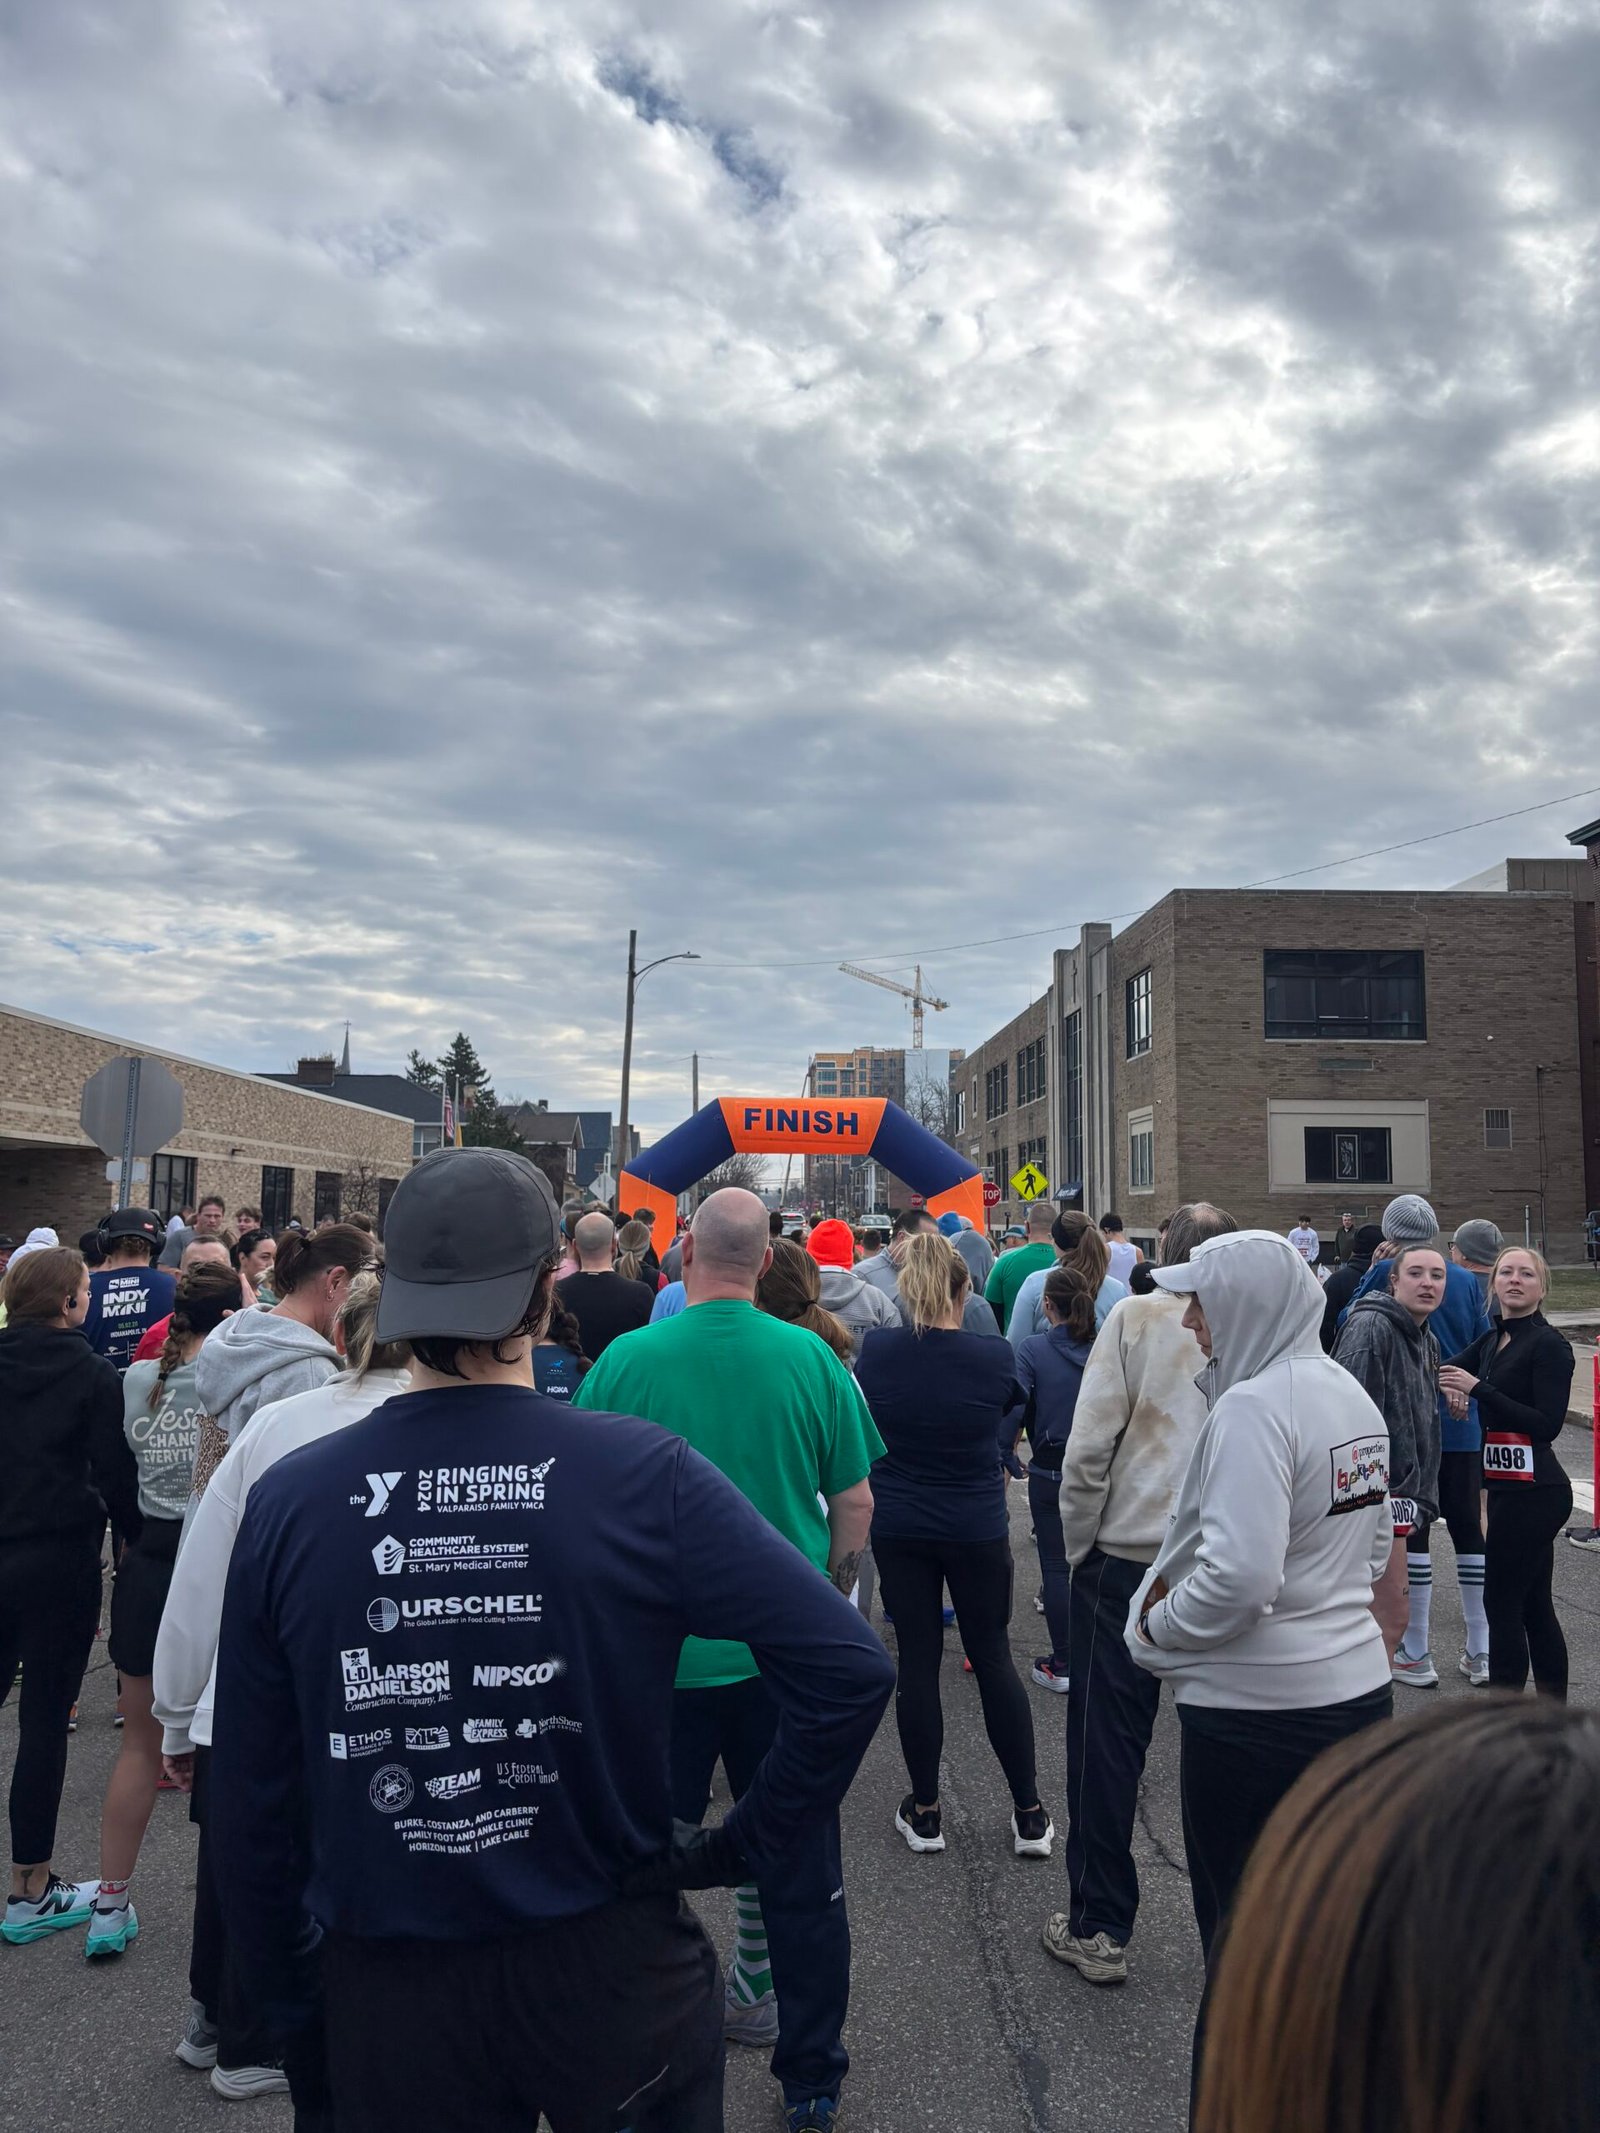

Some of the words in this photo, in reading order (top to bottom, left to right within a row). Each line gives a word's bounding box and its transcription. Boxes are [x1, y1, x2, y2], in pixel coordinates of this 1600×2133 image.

[744, 1108, 858, 1135] FINISH
[983, 1190, 999, 1200] TOP
[102, 1288, 150, 1305] INDY
[102, 1302, 147, 1318] MINI
[148, 1431, 197, 1448] CHANG
[1486, 1446, 1526, 1470] 4498
[436, 1465, 528, 1485] RINGING
[350, 1494, 367, 1505] the
[417, 1470, 433, 1512] 2024
[436, 1485, 459, 1504] IN
[466, 1483, 545, 1502] SPRING
[437, 1503, 488, 1513] VALPARAISO
[490, 1502, 519, 1511] FAMILY
[521, 1502, 544, 1510] YMCA
[409, 1536, 476, 1547] COMMUNITY
[409, 1545, 481, 1557] HEALTHCARE
[409, 1564, 422, 1573] St.
[425, 1562, 451, 1573] Mary
[454, 1560, 491, 1570] Medical
[495, 1560, 528, 1569] Center
[416, 1619, 437, 1627] Global
[438, 1617, 459, 1625] Leader
[483, 1616, 506, 1624] Cutting
[507, 1615, 542, 1623] Technology
[372, 1660, 450, 1681] LARSON
[472, 1662, 554, 1687] NIPSCO
[345, 1675, 451, 1702] DANIELSON
[345, 1695, 396, 1712] Construction
[397, 1695, 436, 1708] Company,
[438, 1691, 453, 1702] Inc.
[474, 1719, 504, 1728] FAMILY
[539, 1715, 583, 1730] NorthShore
[348, 1728, 392, 1747] ETHOS
[471, 1728, 508, 1738] EXPRESS
[438, 1767, 481, 1792] TEAM
[394, 1818, 426, 1830] BURKE,
[427, 1819, 474, 1830] COSTANZA,
[475, 1811, 493, 1824] AND
[494, 1806, 540, 1818] CARBERRY
[402, 1830, 432, 1840] FAMILY
[433, 1832, 454, 1842] FOOT
[456, 1830, 476, 1841] AND
[477, 1821, 504, 1837] ANKLE
[505, 1818, 534, 1828] CLINIC
[409, 1842, 446, 1852] HORIZON
[447, 1844, 472, 1854] BANK
[481, 1834, 501, 1848] LAKE
[502, 1829, 530, 1841] CABLE
